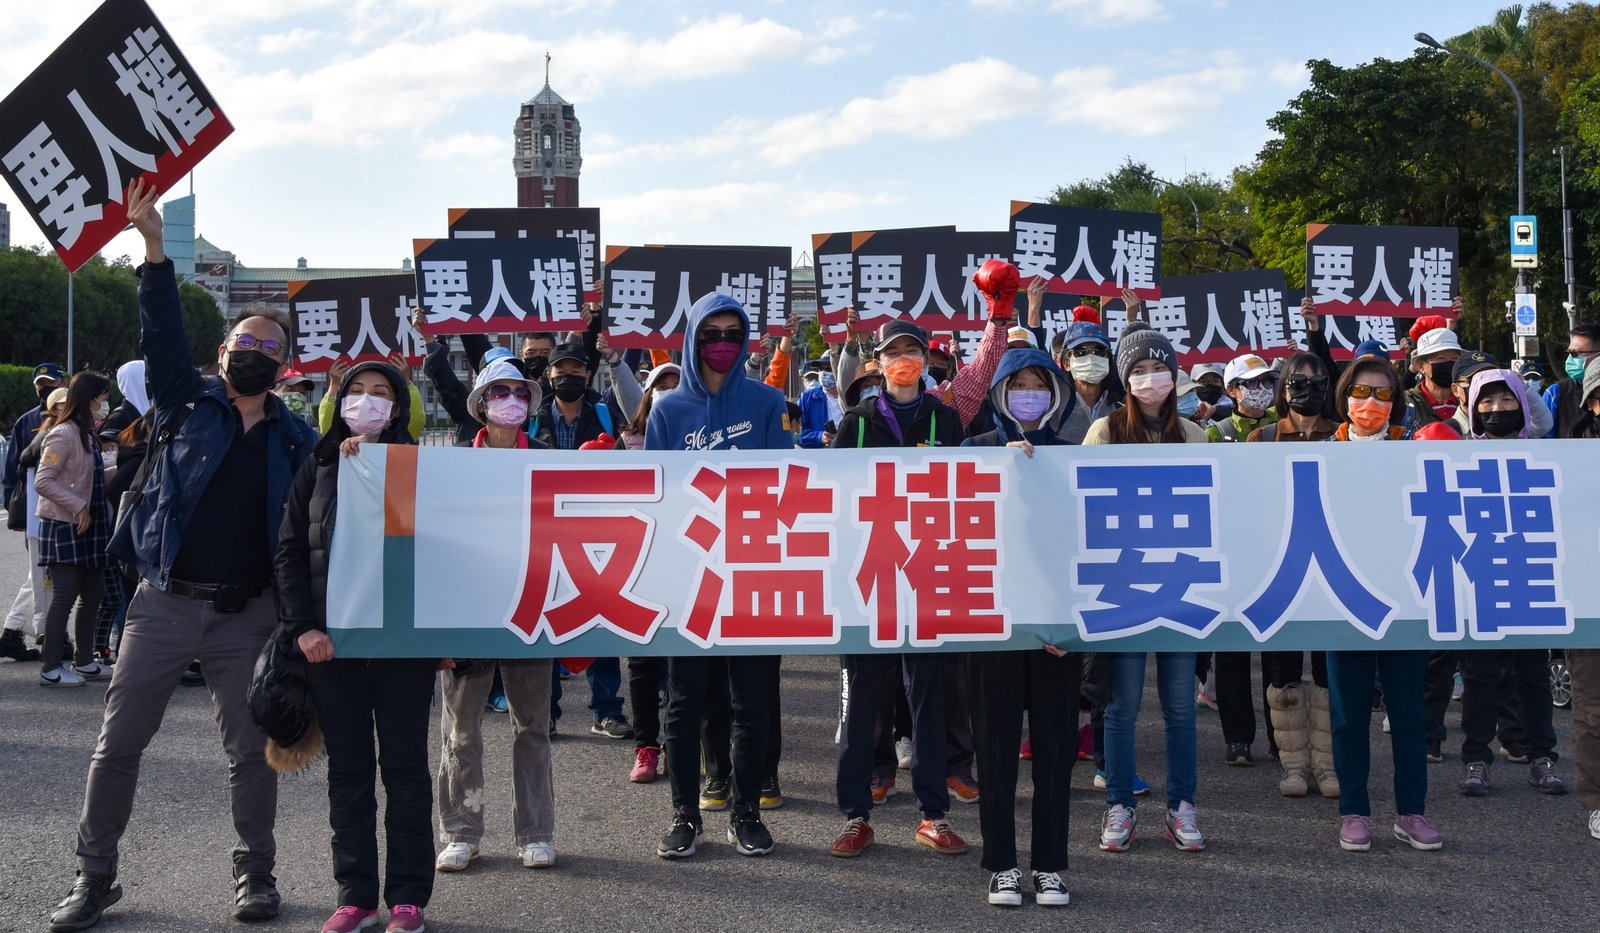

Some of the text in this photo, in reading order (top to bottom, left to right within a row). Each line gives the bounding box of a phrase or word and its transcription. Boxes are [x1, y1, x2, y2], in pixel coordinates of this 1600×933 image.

[1, 25, 216, 251] 要人權
[1013, 220, 1158, 290] 要人權
[1311, 244, 1453, 309] 要人權
[421, 258, 581, 324] 要人權
[1146, 287, 1289, 356] 要人權
[1149, 347, 1169, 362] NY
[508, 457, 1569, 643] 反濫權 要人權
